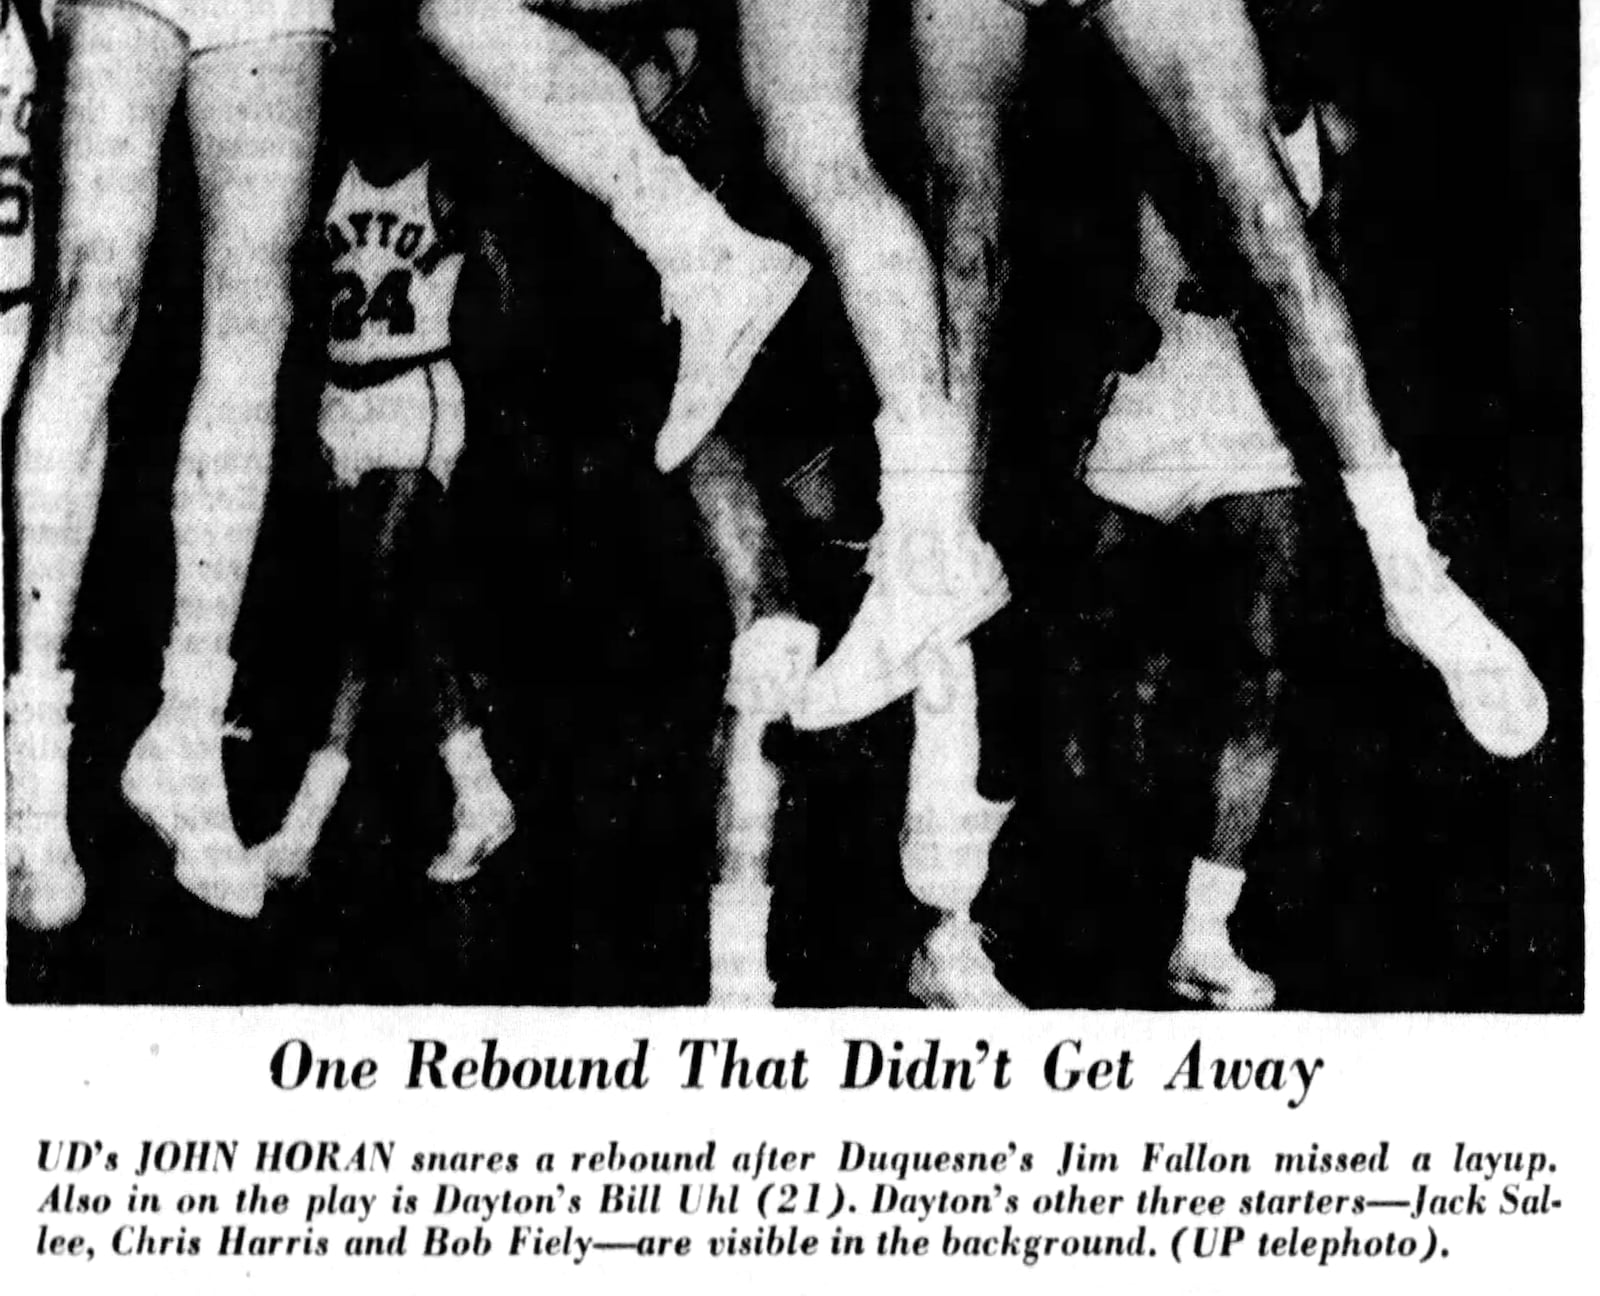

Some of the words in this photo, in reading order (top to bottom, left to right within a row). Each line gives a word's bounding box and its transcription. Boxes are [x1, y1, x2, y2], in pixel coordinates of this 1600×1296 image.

[330, 268, 416, 342] 24
[269, 1039, 378, 1090] One
[407, 1038, 649, 1090] Rebound
[679, 1038, 809, 1090] That
[840, 1039, 1011, 1091] Didn't
[1043, 1039, 1133, 1091] Get
[1163, 1039, 1325, 1109] Away
[38, 1140, 118, 1171] UD's
[135, 1140, 238, 1176] JOHN
[256, 1141, 395, 1172] HORAN
[411, 1152, 518, 1172] snares
[536, 1153, 554, 1172] a
[571, 1140, 716, 1172] rebound
[732, 1141, 815, 1180] after
[839, 1141, 1033, 1181] Duquesne's
[1057, 1141, 1117, 1176] Jim
[1143, 1142, 1249, 1173] Fallon
[1275, 1141, 1389, 1173] missed
[1412, 1152, 1431, 1172] a
[1454, 1142, 1556, 1181] layup.
[39, 1183, 111, 1213] Also
[128, 1184, 159, 1213] in
[176, 1194, 218, 1213] on
[236, 1183, 289, 1214] the
[306, 1184, 375, 1222] play
[392, 1185, 418, 1214] is
[434, 1184, 581, 1222] Dayton's
[600, 1183, 661, 1214] Bill
[679, 1183, 739, 1214] Uhl
[753, 1183, 856, 1219] (21).
[872, 1183, 1018, 1222] Dayton's
[1033, 1184, 1124, 1214] other
[1137, 1185, 1226, 1215] three
[1499, 1184, 1562, 1215] Sal-
[37, 1225, 95, 1259] lee,
[112, 1225, 201, 1255] Chris
[218, 1225, 328, 1256] Harris
[345, 1225, 407, 1256] and
[424, 1226, 492, 1256] Bob
[710, 1225, 819, 1257] visible
[831, 1226, 864, 1255] in
[877, 1225, 929, 1256] the
[942, 1225, 1156, 1266] background.
[1171, 1226, 1245, 1263] (UP
[1258, 1226, 1449, 1266] telephoto).
